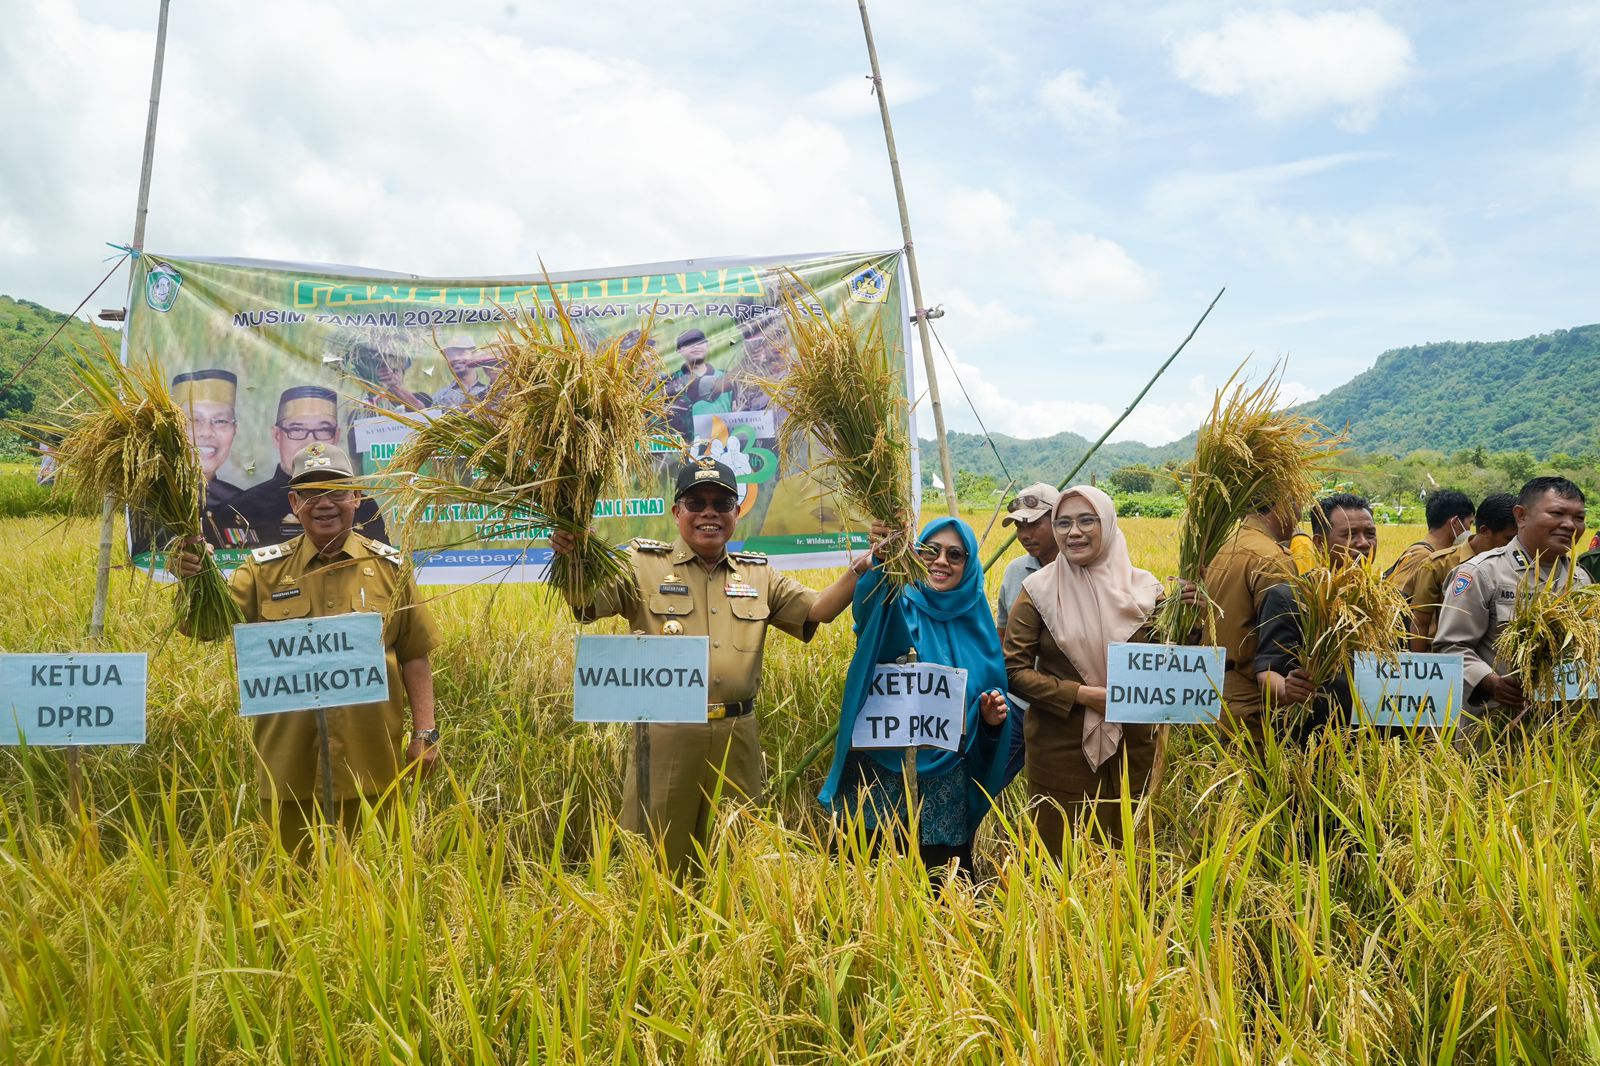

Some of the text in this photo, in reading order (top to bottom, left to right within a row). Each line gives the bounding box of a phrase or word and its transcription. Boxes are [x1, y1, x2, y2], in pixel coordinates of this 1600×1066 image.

[233, 309, 307, 327] MUSIM
[314, 313, 398, 328] TANAM
[636, 303, 699, 318] KOTA
[268, 632, 354, 658] WAKIL
[1127, 652, 1207, 673] KEPALA
[1375, 661, 1444, 681] KETUA
[31, 664, 122, 687] KETUA
[243, 666, 384, 699] WALIKOTA
[578, 667, 704, 688] WALIKOTA
[868, 672, 951, 698] KETUA
[1110, 685, 1220, 707] DINAS PKP
[1380, 694, 1437, 714] KTNA
[37, 706, 115, 727] DPRD
[866, 715, 950, 741] TP PKK
